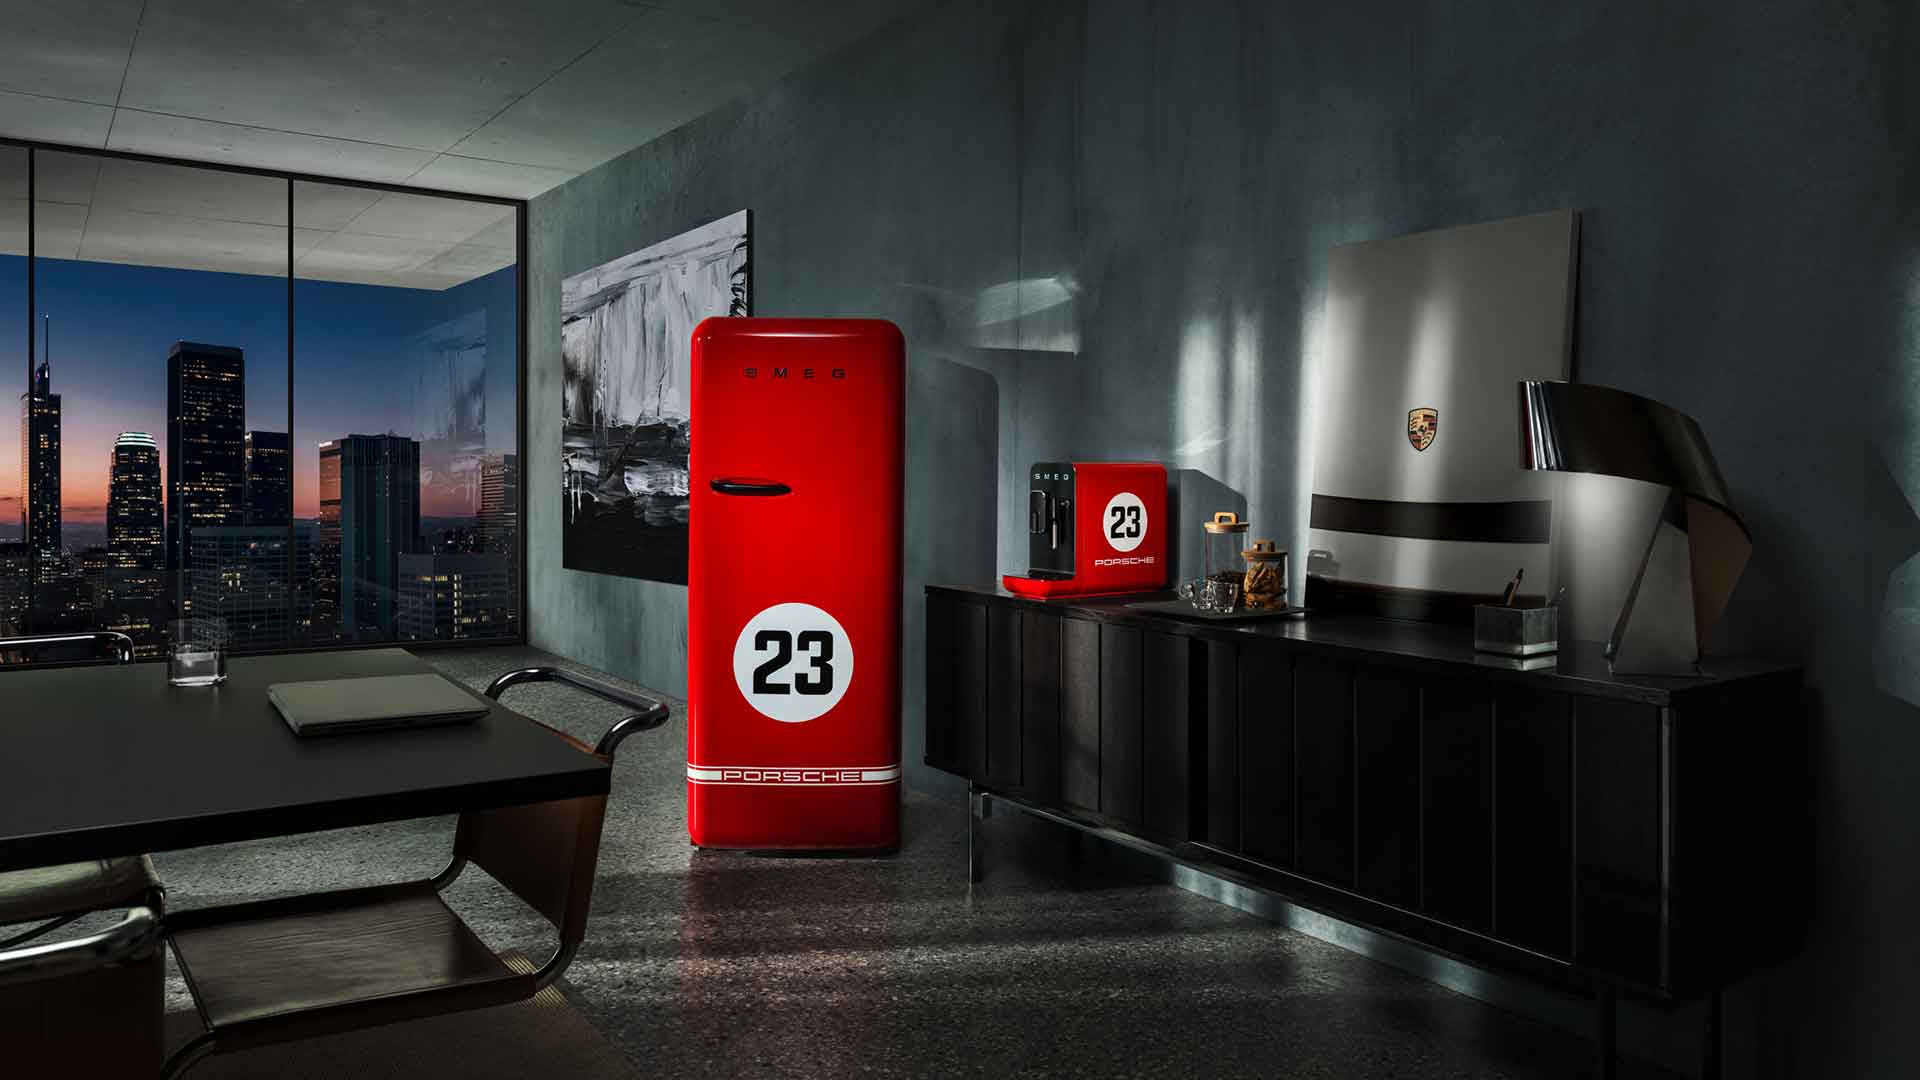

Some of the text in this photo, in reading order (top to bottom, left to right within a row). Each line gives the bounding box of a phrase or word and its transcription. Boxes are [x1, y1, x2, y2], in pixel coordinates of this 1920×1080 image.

[744, 367, 846, 379] SMEG
[1034, 473, 1069, 481] SMEG
[1111, 506, 1141, 539] 23
[1094, 556, 1155, 567] PORSCHE
[753, 630, 834, 695] 23
[723, 771, 861, 782] PORSCHE
